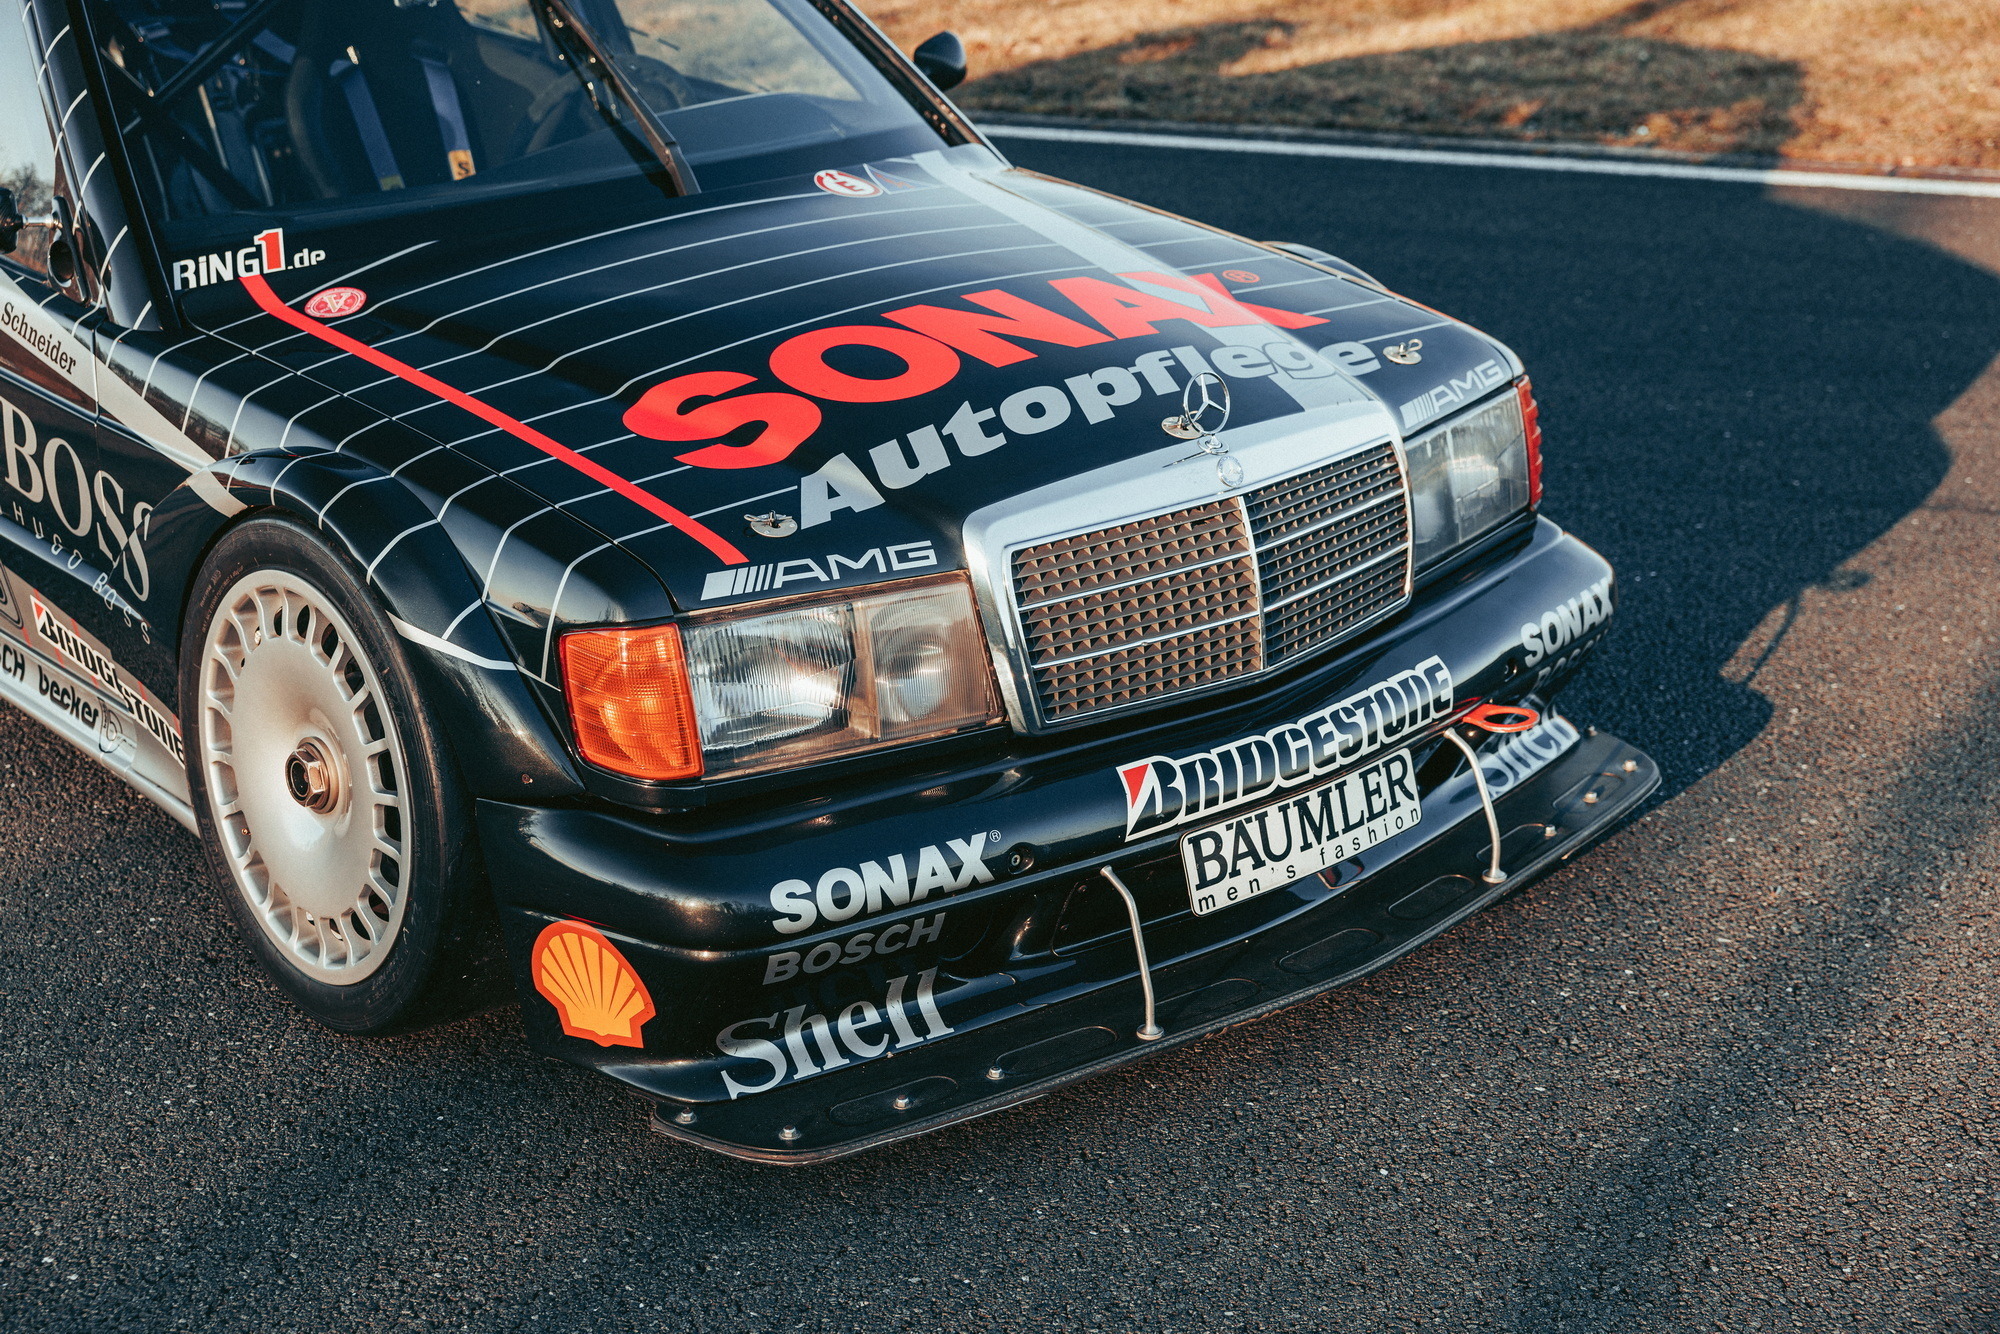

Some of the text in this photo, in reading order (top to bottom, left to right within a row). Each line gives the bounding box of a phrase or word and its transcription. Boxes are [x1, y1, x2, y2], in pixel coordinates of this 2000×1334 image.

[1, 301, 77, 376] Schneider
[1428, 358, 1506, 415] AMG
[799, 339, 1382, 531] Autopflege
[0, 395, 154, 603] BOSS
[12, 500, 84, 571] HUGO
[92, 572, 151, 646] BOSS
[772, 539, 939, 590] AMG
[1520, 575, 1615, 669] SONAX
[37, 663, 100, 731] becker
[1116, 654, 1455, 843] BRIDGESTONE
[1187, 751, 1416, 892] BÄUMLER
[1318, 805, 1421, 867] fashion
[761, 911, 948, 987] BOSCH
[715, 964, 956, 1101] Shell
